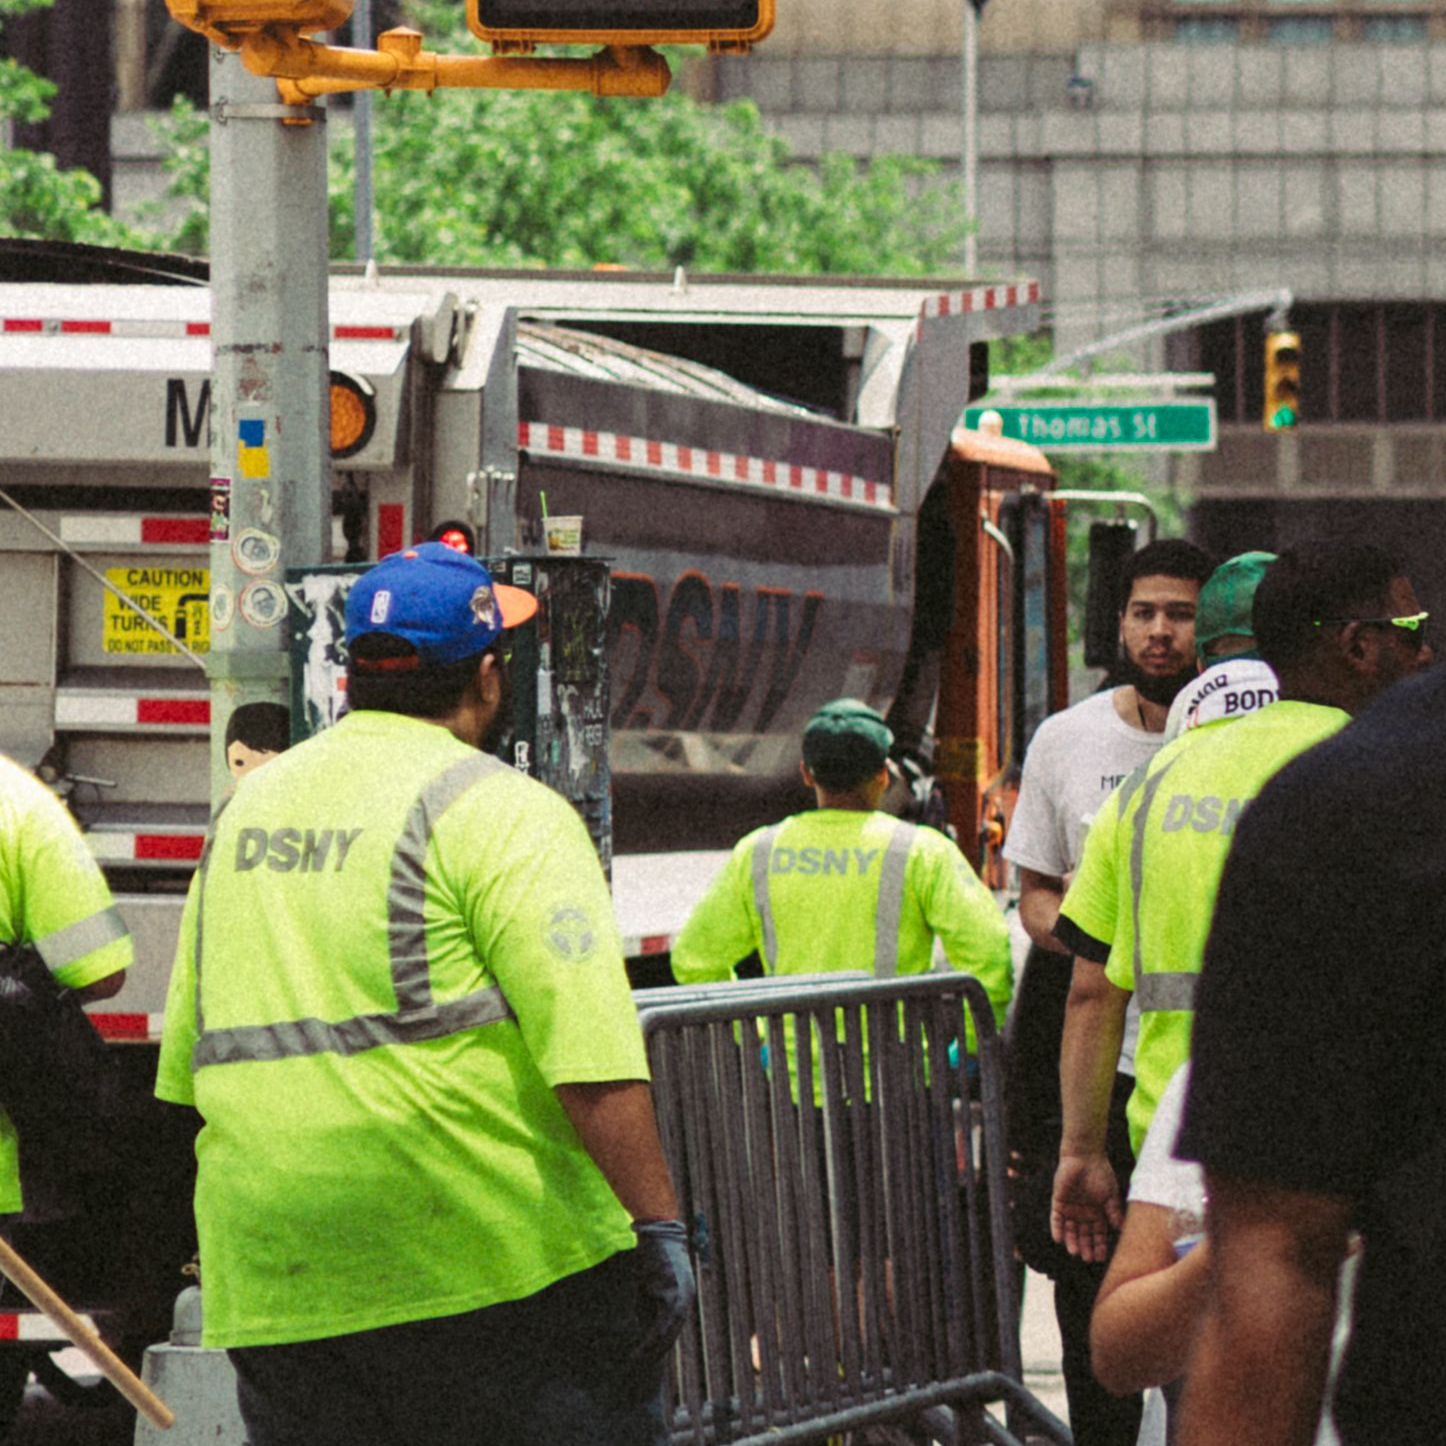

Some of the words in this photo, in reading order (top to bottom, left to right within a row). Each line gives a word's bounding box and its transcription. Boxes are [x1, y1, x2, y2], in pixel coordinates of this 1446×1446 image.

[1017, 408, 1121, 441] Thomas
[1131, 408, 1160, 441] St
[126, 569, 204, 587] CAUTION
[1223, 688, 1281, 715] BOD
[233, 825, 366, 876] DSNY
[770, 844, 882, 881] DSNY
